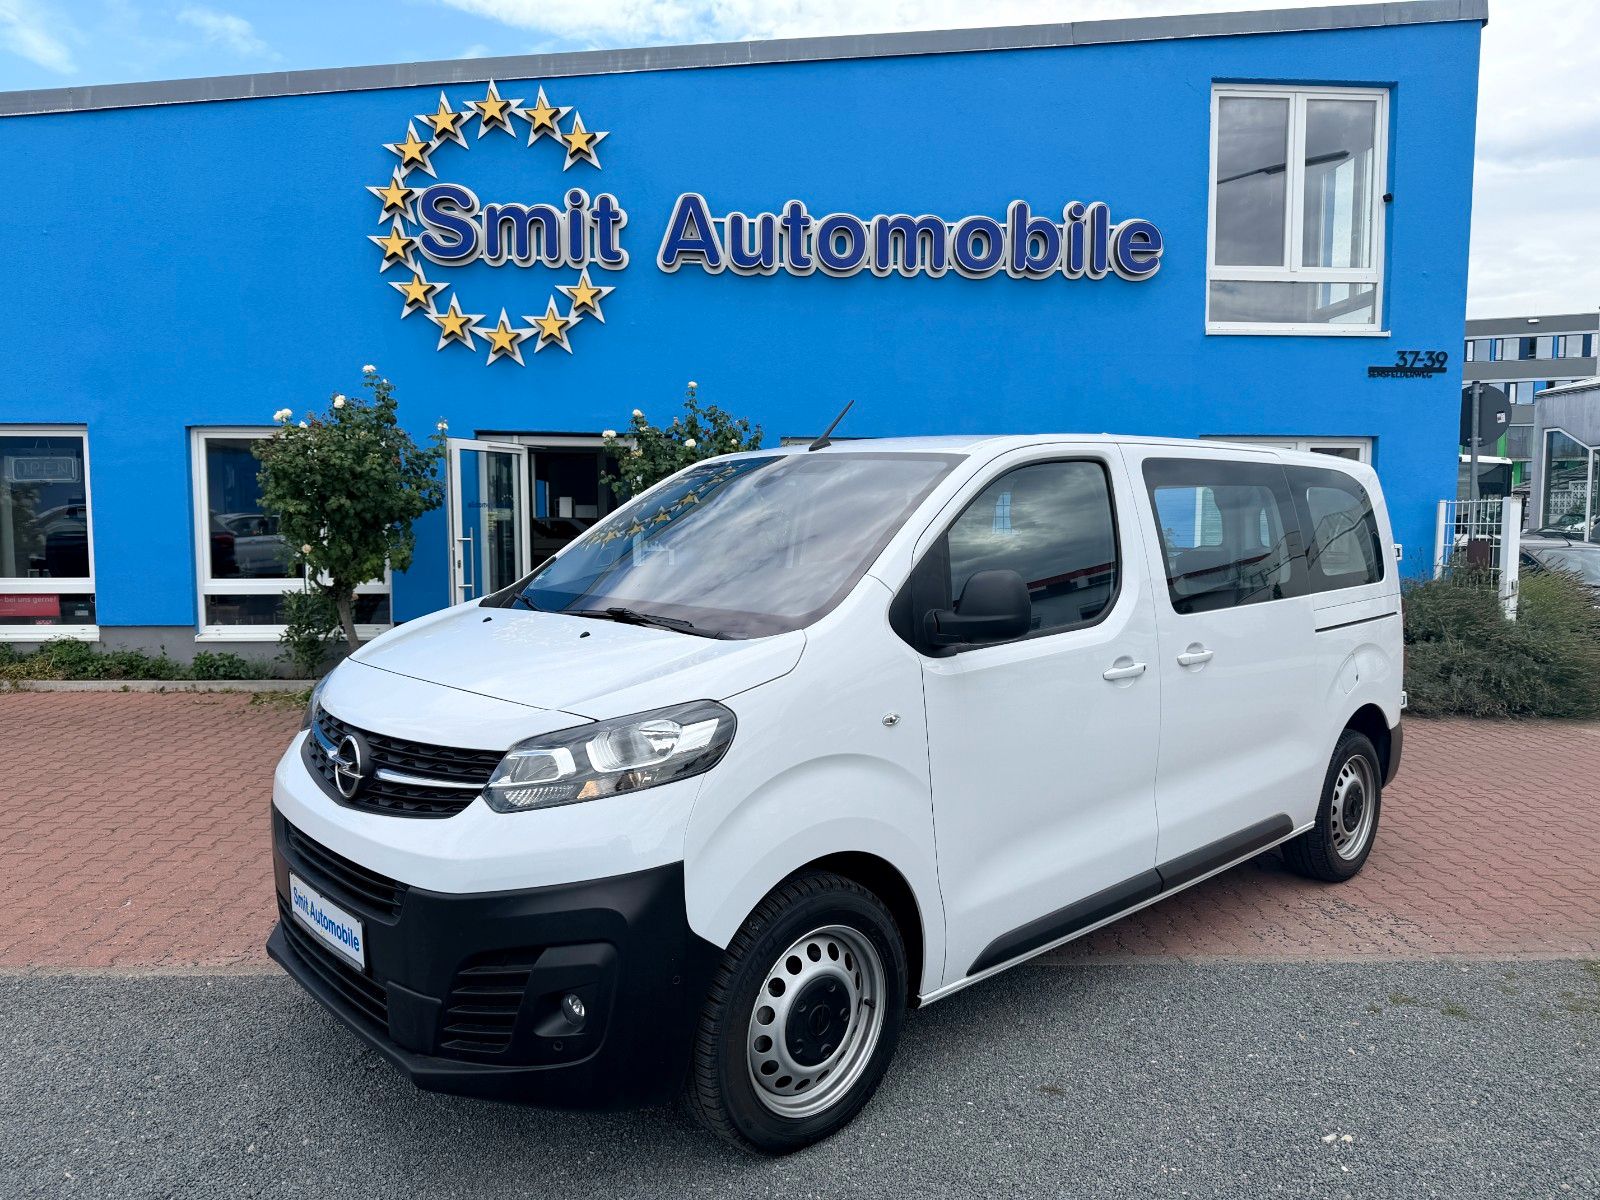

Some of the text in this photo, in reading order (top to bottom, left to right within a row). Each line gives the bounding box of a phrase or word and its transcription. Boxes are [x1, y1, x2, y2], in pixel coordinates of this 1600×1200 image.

[418, 184, 1163, 277] Smit Automobile
[1395, 351, 1448, 368] 37-39
[16, 460, 73, 477] OPEN
[4, 595, 16, 603] bei
[293, 886, 360, 952] Smit Automobile
